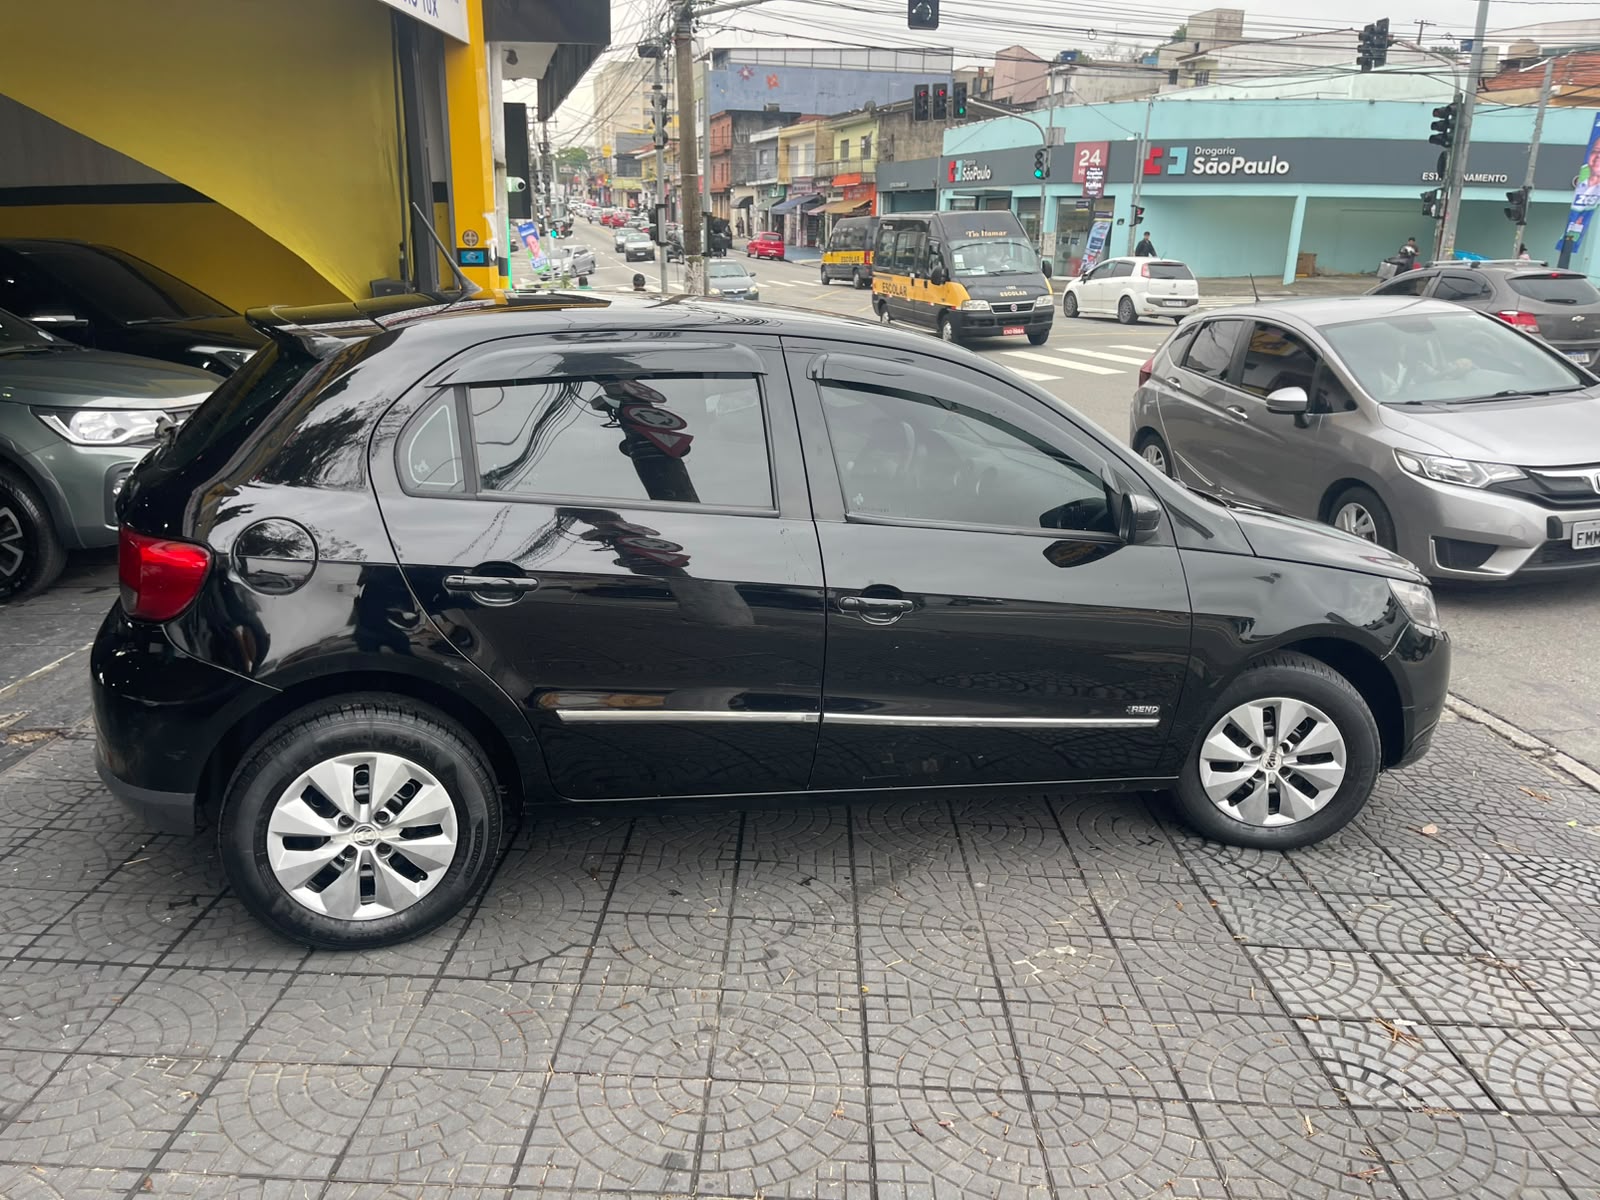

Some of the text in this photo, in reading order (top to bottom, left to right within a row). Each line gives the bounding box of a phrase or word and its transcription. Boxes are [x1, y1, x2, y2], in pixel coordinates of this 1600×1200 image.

[1079, 148, 1101, 167] 24
[1194, 146, 1236, 157] Drogaria
[962, 164, 992, 181] SãoPaulo
[1192, 154, 1290, 175] SãoPaulo
[1422, 172, 1508, 183] ESTNAMENTO
[882, 281, 908, 297] ESCOLAR
